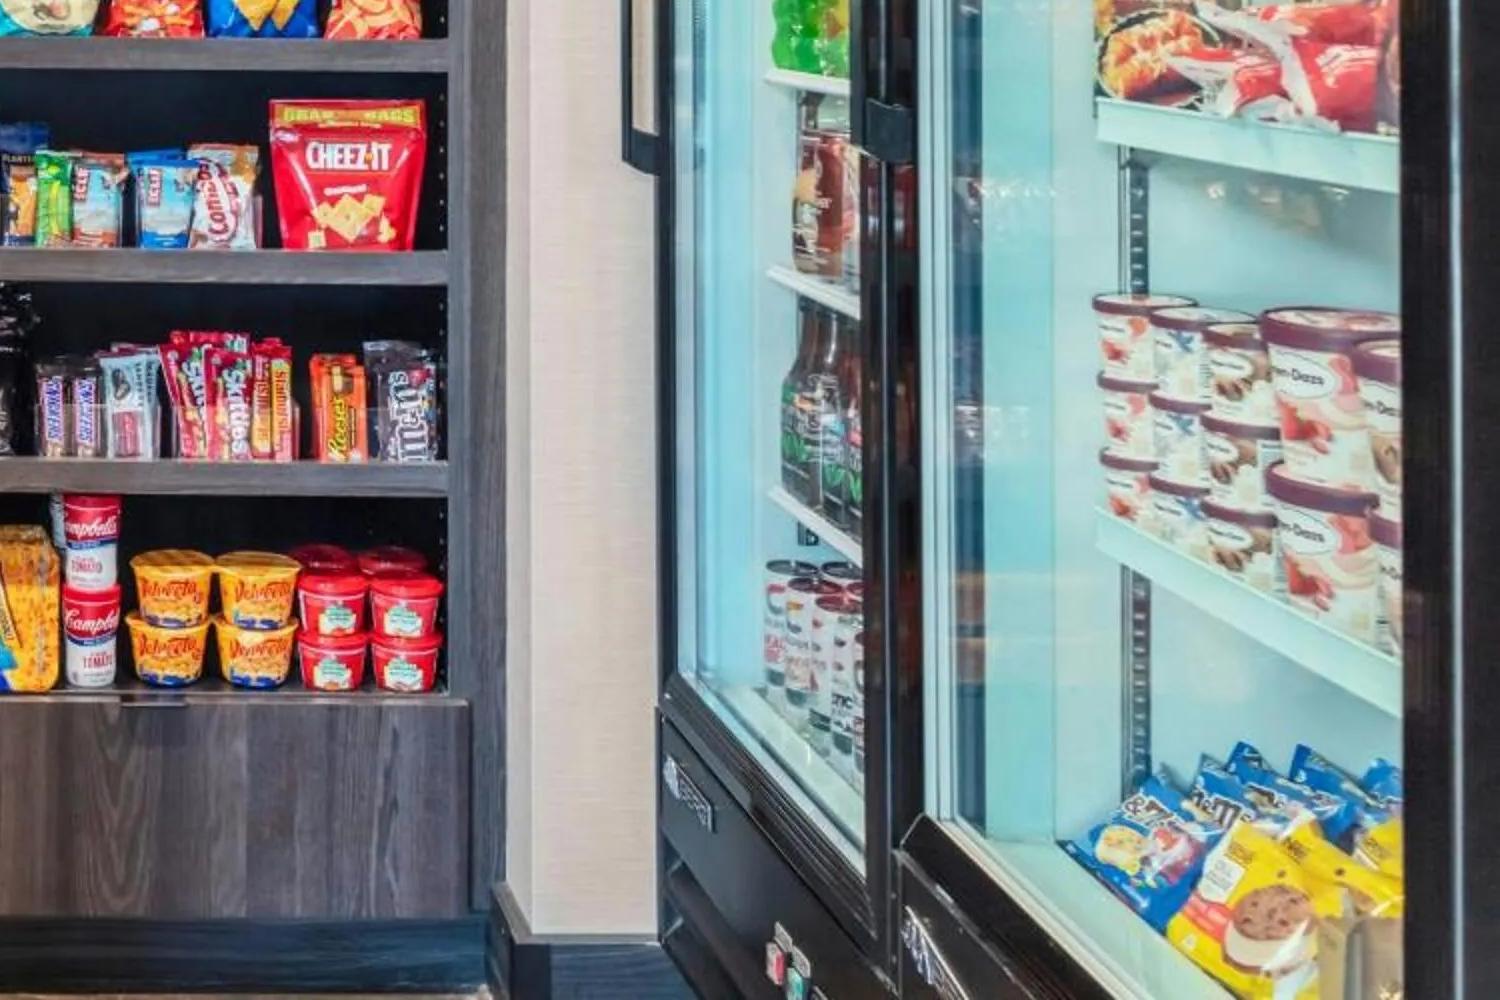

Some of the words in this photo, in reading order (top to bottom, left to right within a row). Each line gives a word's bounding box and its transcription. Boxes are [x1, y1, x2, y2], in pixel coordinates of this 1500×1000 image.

[306, 139, 392, 171] CHEEZ-IT
[45, 375, 63, 442] SNICKERS
[77, 377, 95, 443] SNICKERS
[223, 366, 249, 456] Skittles
[65, 514, 117, 535] ampbell's
